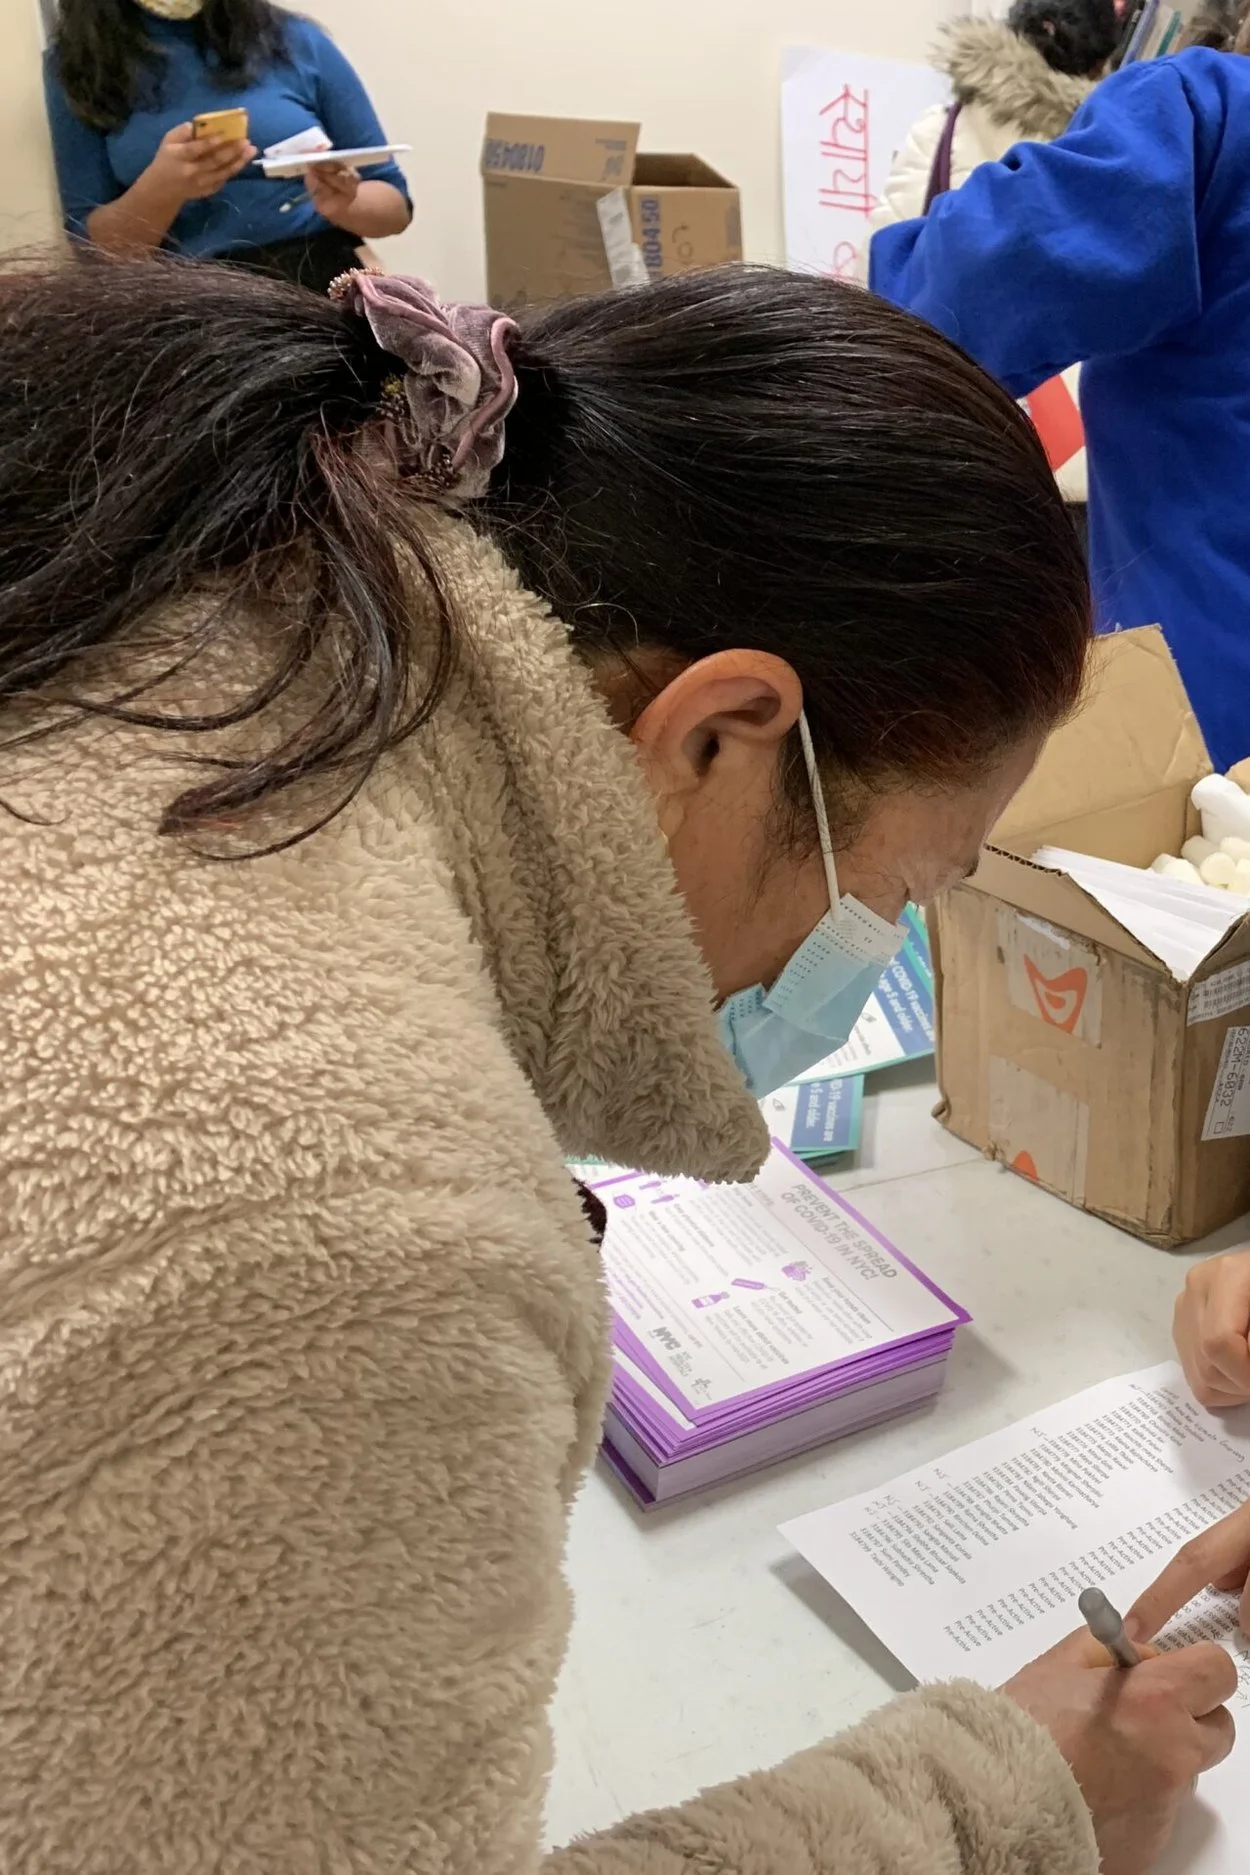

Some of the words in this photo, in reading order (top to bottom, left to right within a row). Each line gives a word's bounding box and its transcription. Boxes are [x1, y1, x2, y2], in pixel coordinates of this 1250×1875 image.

[780, 1188, 799, 1207] OF
[793, 1200, 839, 1245] COVID-19
[833, 1239, 852, 1258] IN
[845, 1250, 878, 1283] NYC!
[791, 1179, 839, 1225] PREVENT
[833, 1218, 860, 1244] THE
[853, 1237, 898, 1281] SPREAD
[652, 1324, 681, 1354] NYC
